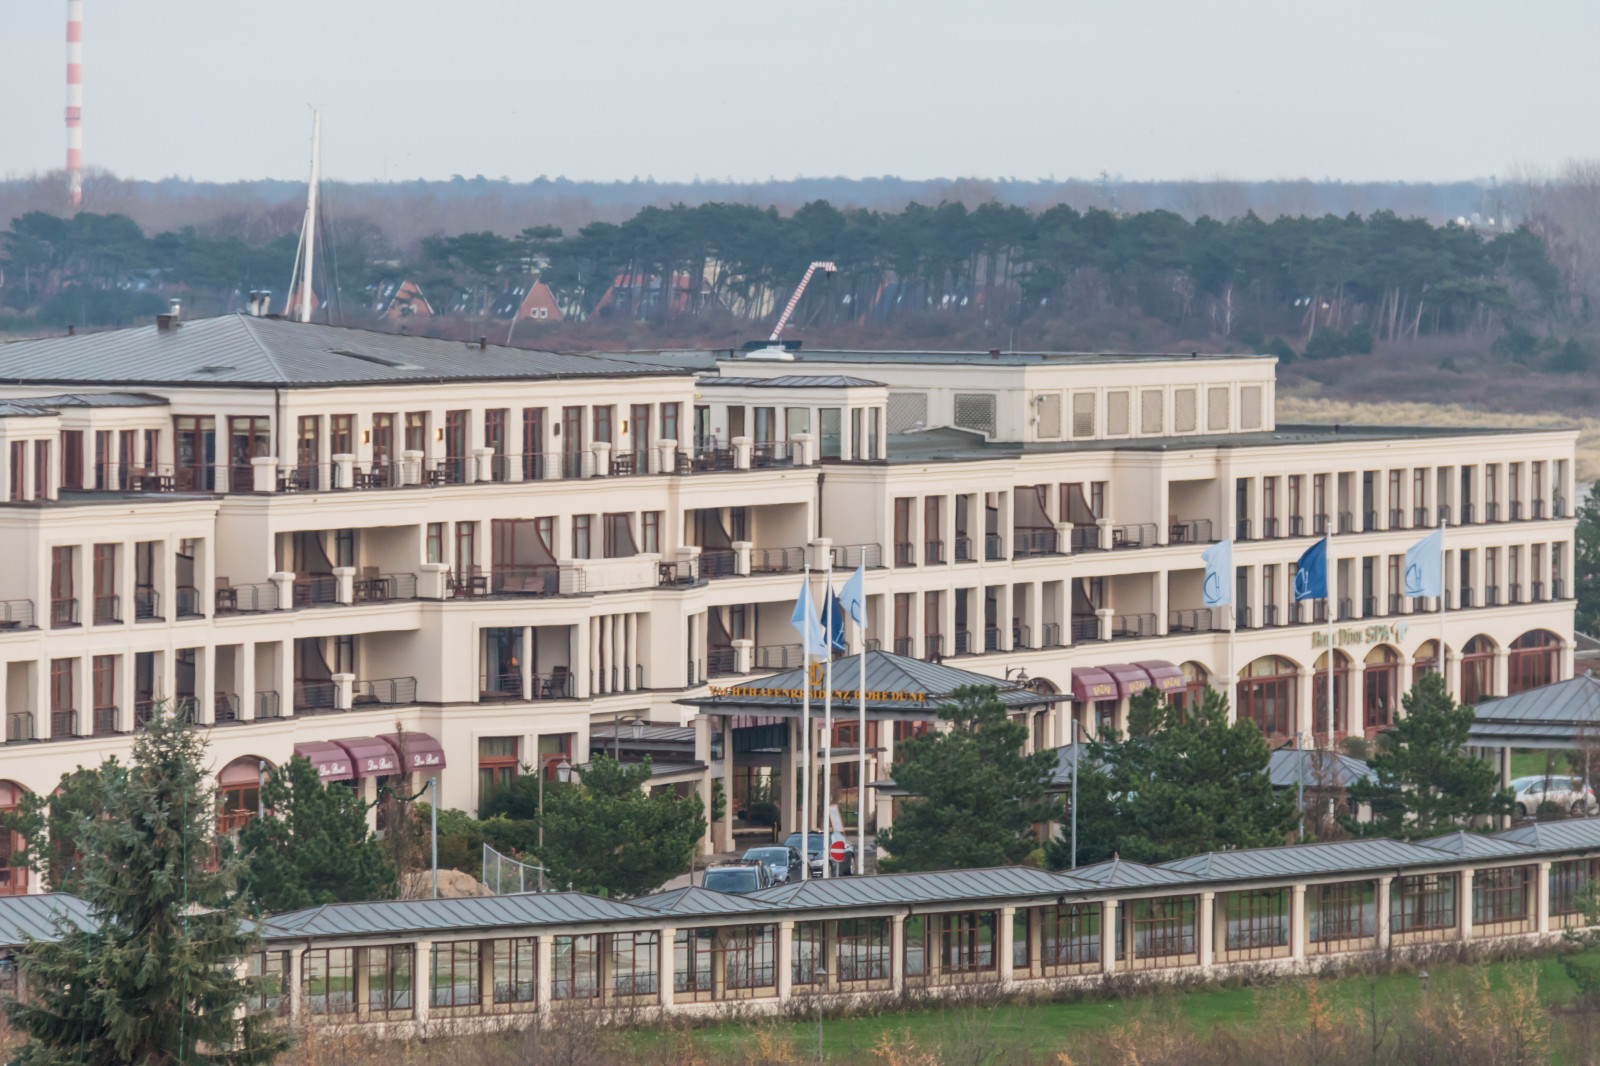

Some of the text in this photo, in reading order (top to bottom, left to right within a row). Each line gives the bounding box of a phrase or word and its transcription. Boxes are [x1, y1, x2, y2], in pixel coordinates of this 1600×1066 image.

[1312, 631, 1336, 648] HOE
[1365, 624, 1389, 643] SPA
[891, 689, 926, 702] DÜNE
